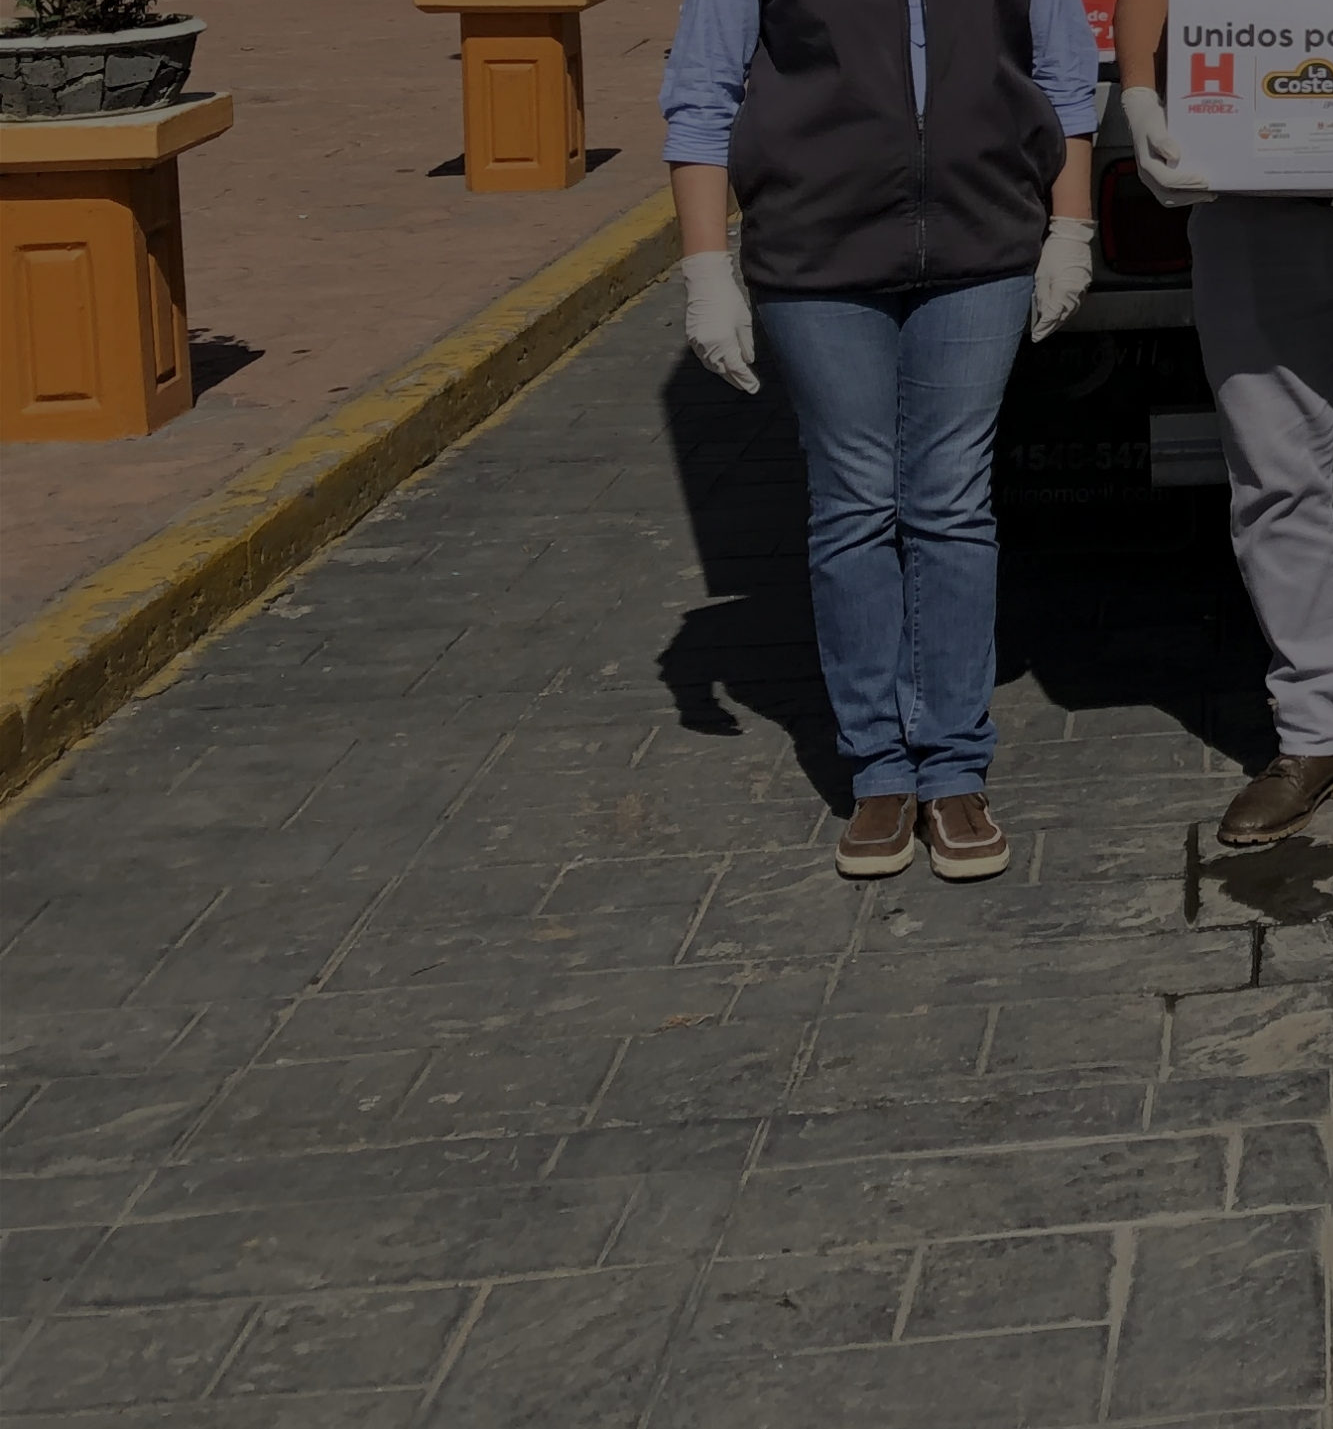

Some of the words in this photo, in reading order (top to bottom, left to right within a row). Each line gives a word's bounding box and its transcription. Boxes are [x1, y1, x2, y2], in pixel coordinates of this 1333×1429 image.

[1087, 10, 1108, 21] de
[1183, 22, 1293, 48] Unidos
[1191, 53, 1234, 94] H
[1308, 65, 1327, 79] La
[1188, 104, 1234, 114] HERDEZ
[1009, 442, 1150, 471] 1546-547
